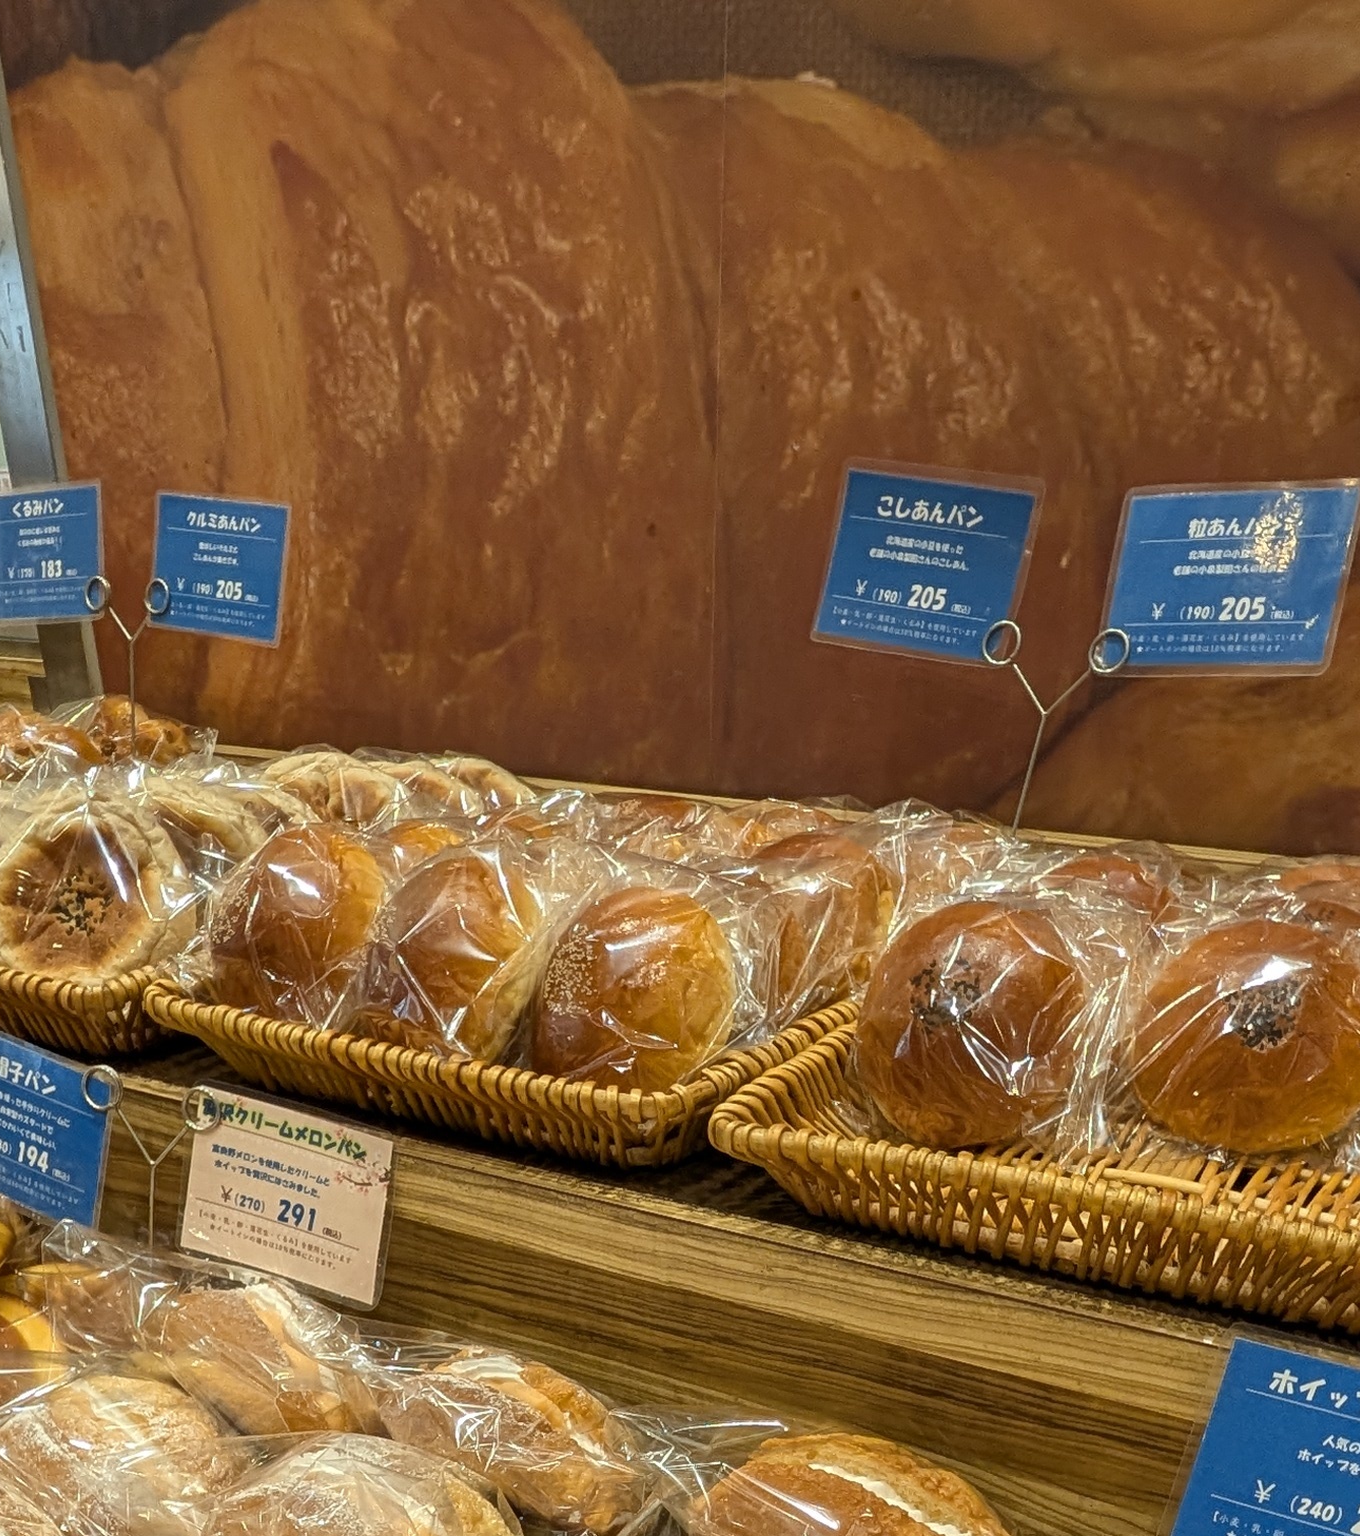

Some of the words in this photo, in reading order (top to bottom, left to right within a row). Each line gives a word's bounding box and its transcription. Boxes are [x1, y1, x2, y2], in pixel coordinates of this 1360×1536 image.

[12, 497, 64, 518] くるみパン
[186, 511, 261, 533] クルミあんパン
[876, 495, 984, 528] こしあんパン
[41, 559, 63, 579] 183
[177, 577, 185, 591] ¥
[215, 579, 243, 601] 205
[856, 578, 868, 597] ¥
[872, 587, 902, 605] (190)
[907, 583, 947, 612] 205
[1151, 602, 1165, 620] ¥
[1180, 605, 1215, 621] (190)
[1219, 596, 1267, 621] 205
[17, 1140, 50, 1174] 194
[220, 1185, 233, 1203] ¥
[234, 1191, 266, 1214] (270)
[277, 1198, 317, 1232] 291
[1253, 1478, 1277, 1504] ¥
[1289, 1494, 1344, 1526] (240)
